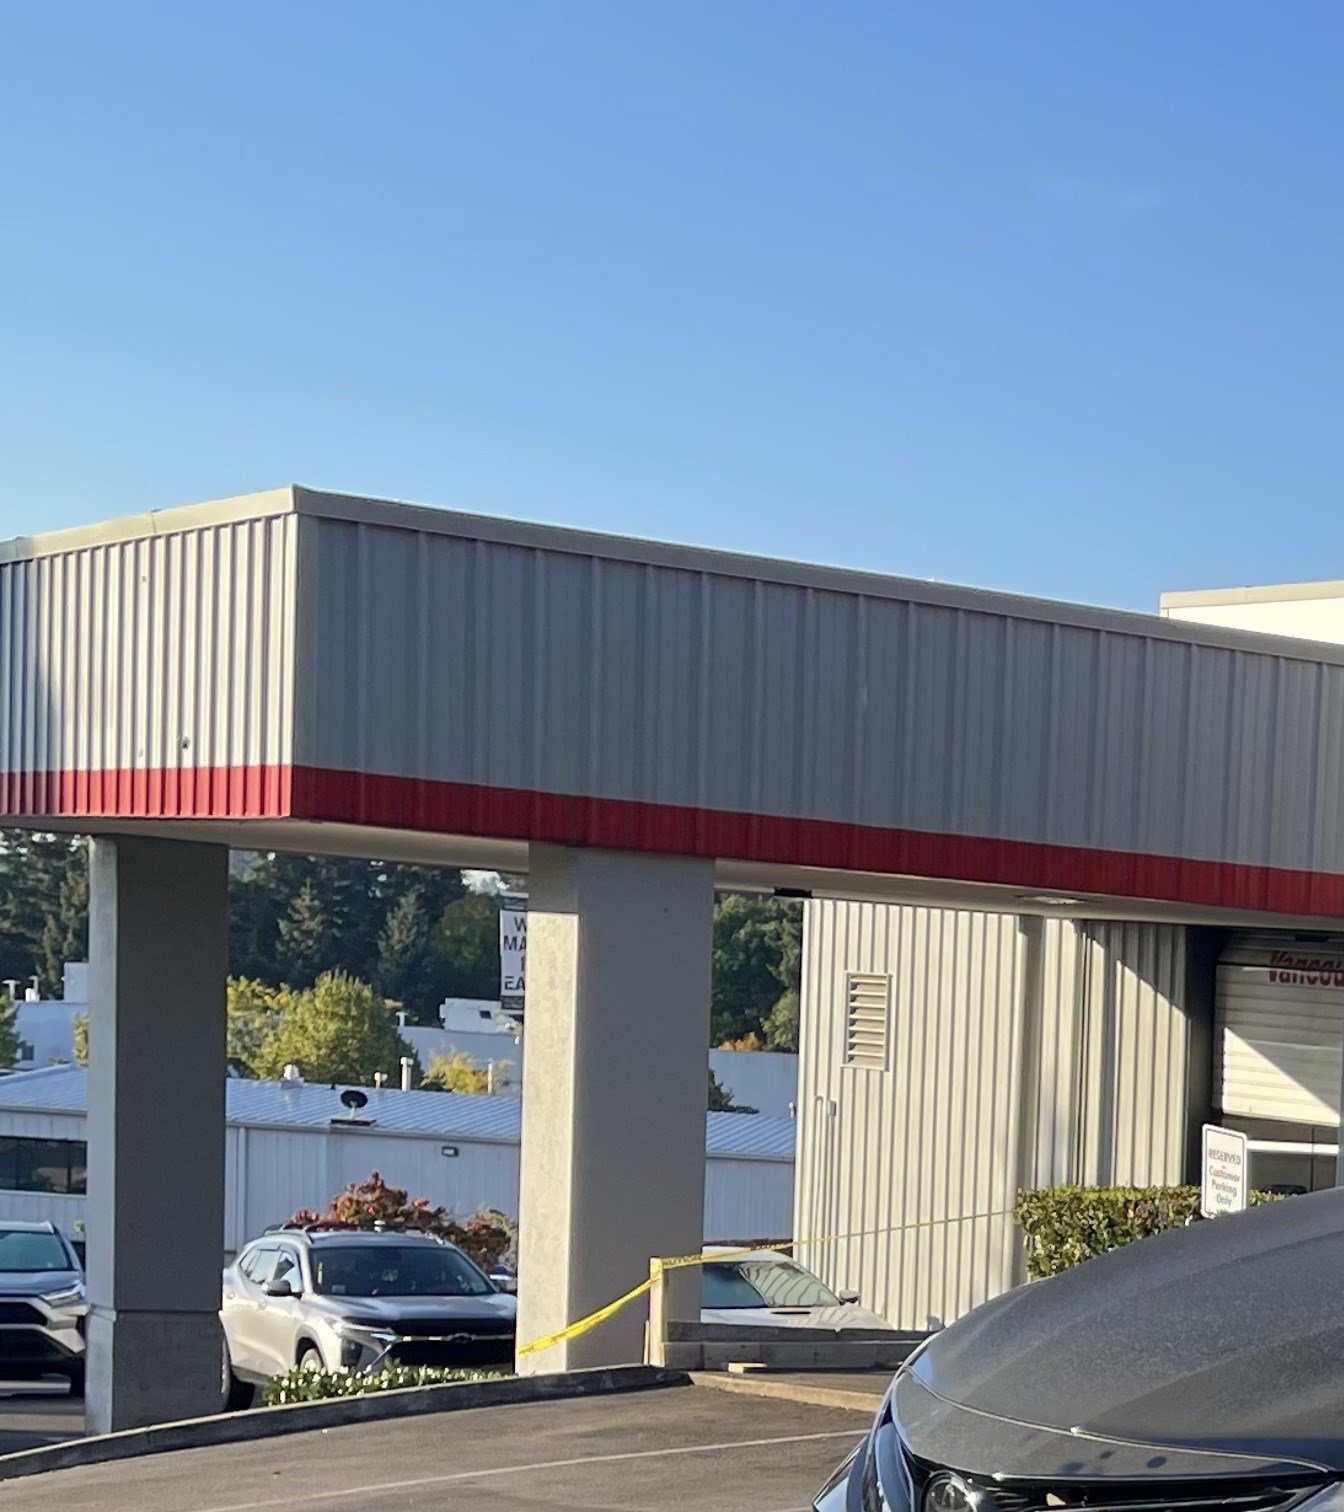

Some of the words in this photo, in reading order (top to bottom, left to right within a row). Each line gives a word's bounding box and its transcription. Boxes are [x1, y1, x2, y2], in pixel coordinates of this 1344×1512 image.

[514, 916, 527, 932] W
[503, 935, 527, 951] MA
[504, 976, 526, 992] EA
[1207, 1148, 1241, 1166] RESERVED
